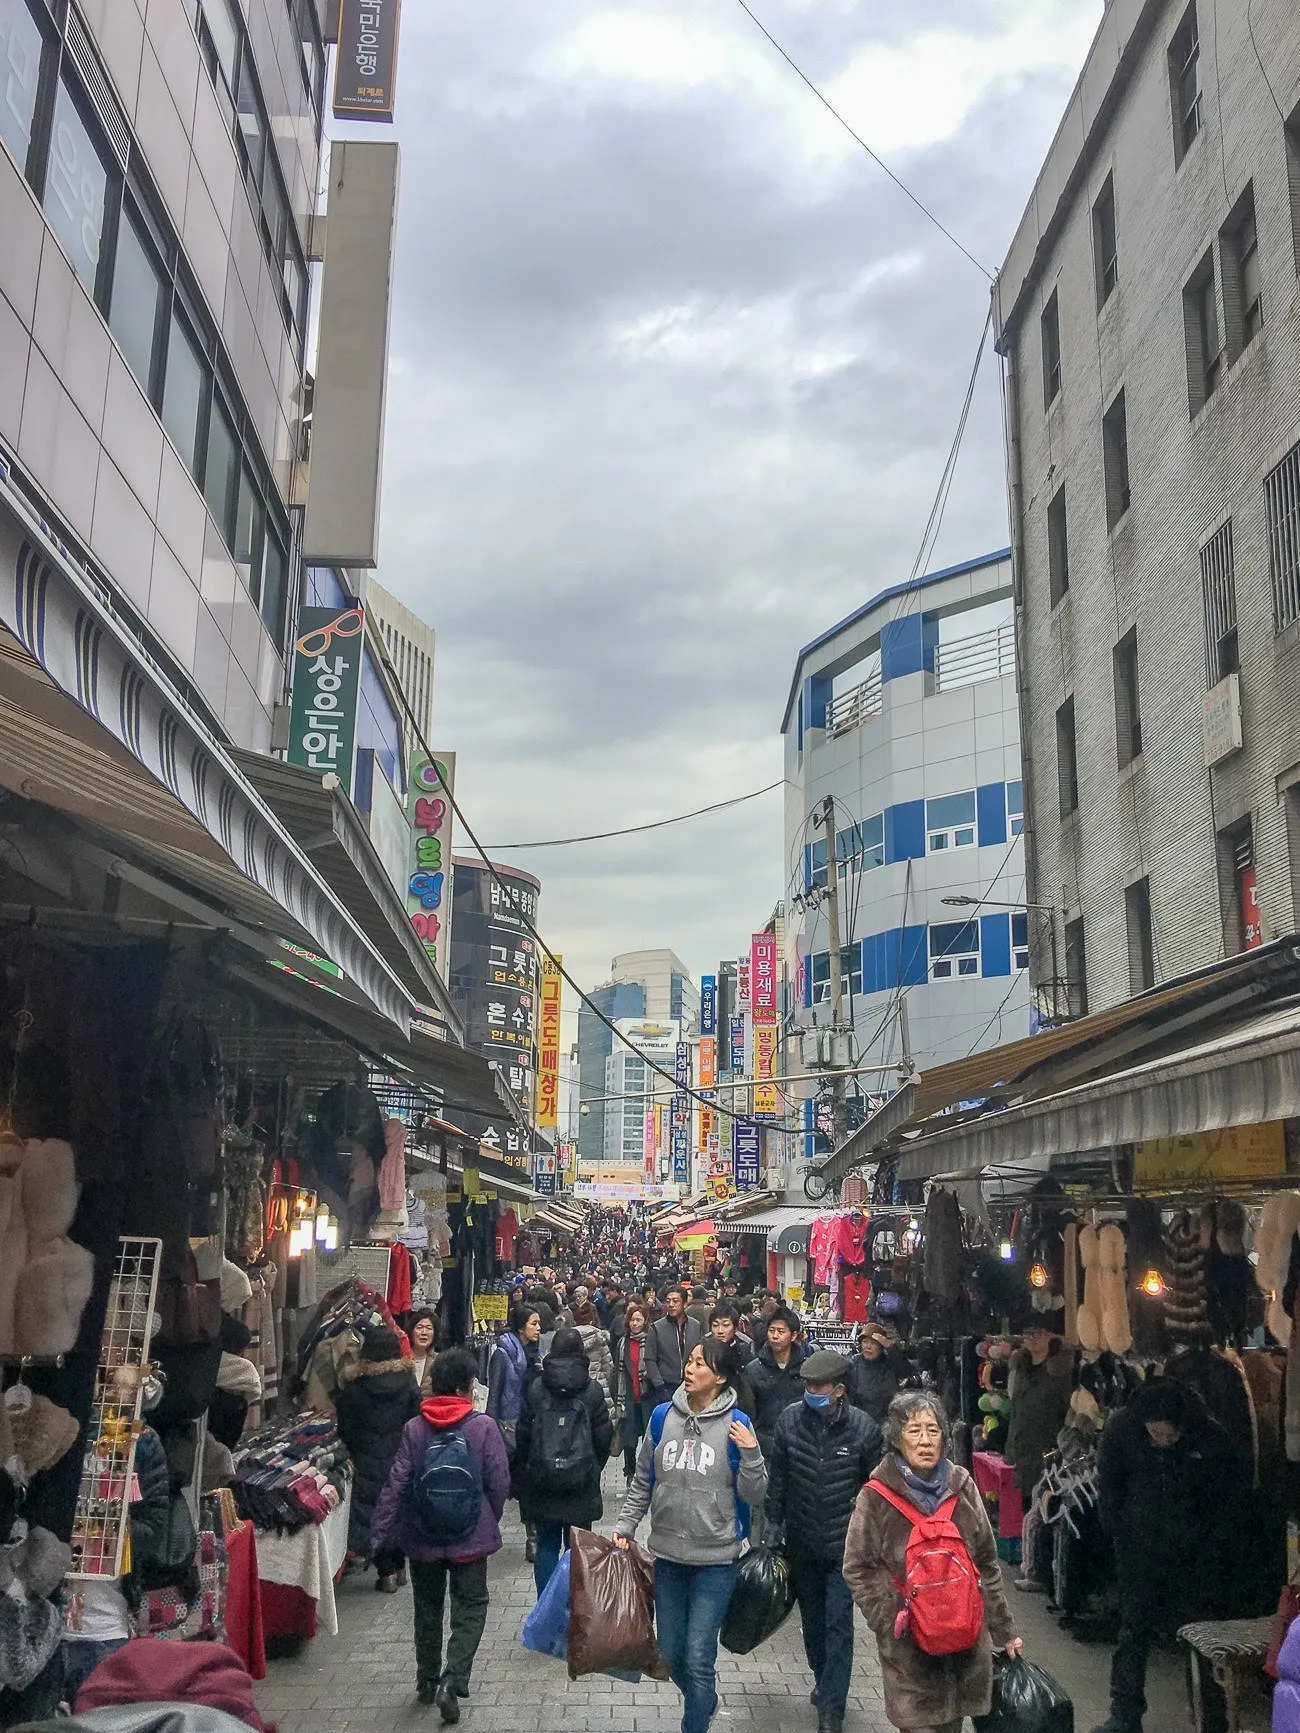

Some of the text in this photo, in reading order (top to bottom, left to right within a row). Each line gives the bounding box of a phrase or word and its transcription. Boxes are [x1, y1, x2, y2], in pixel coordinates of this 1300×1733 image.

[302, 655, 349, 774] 상은안
[739, 966, 750, 1000] 부동산
[755, 946, 773, 1006] 미용재료
[703, 992, 712, 1029] 우리은행
[540, 981, 558, 1117] 그릇도매상가
[737, 1127, 758, 1182] 그릇도매
[661, 1439, 716, 1476] GAP
